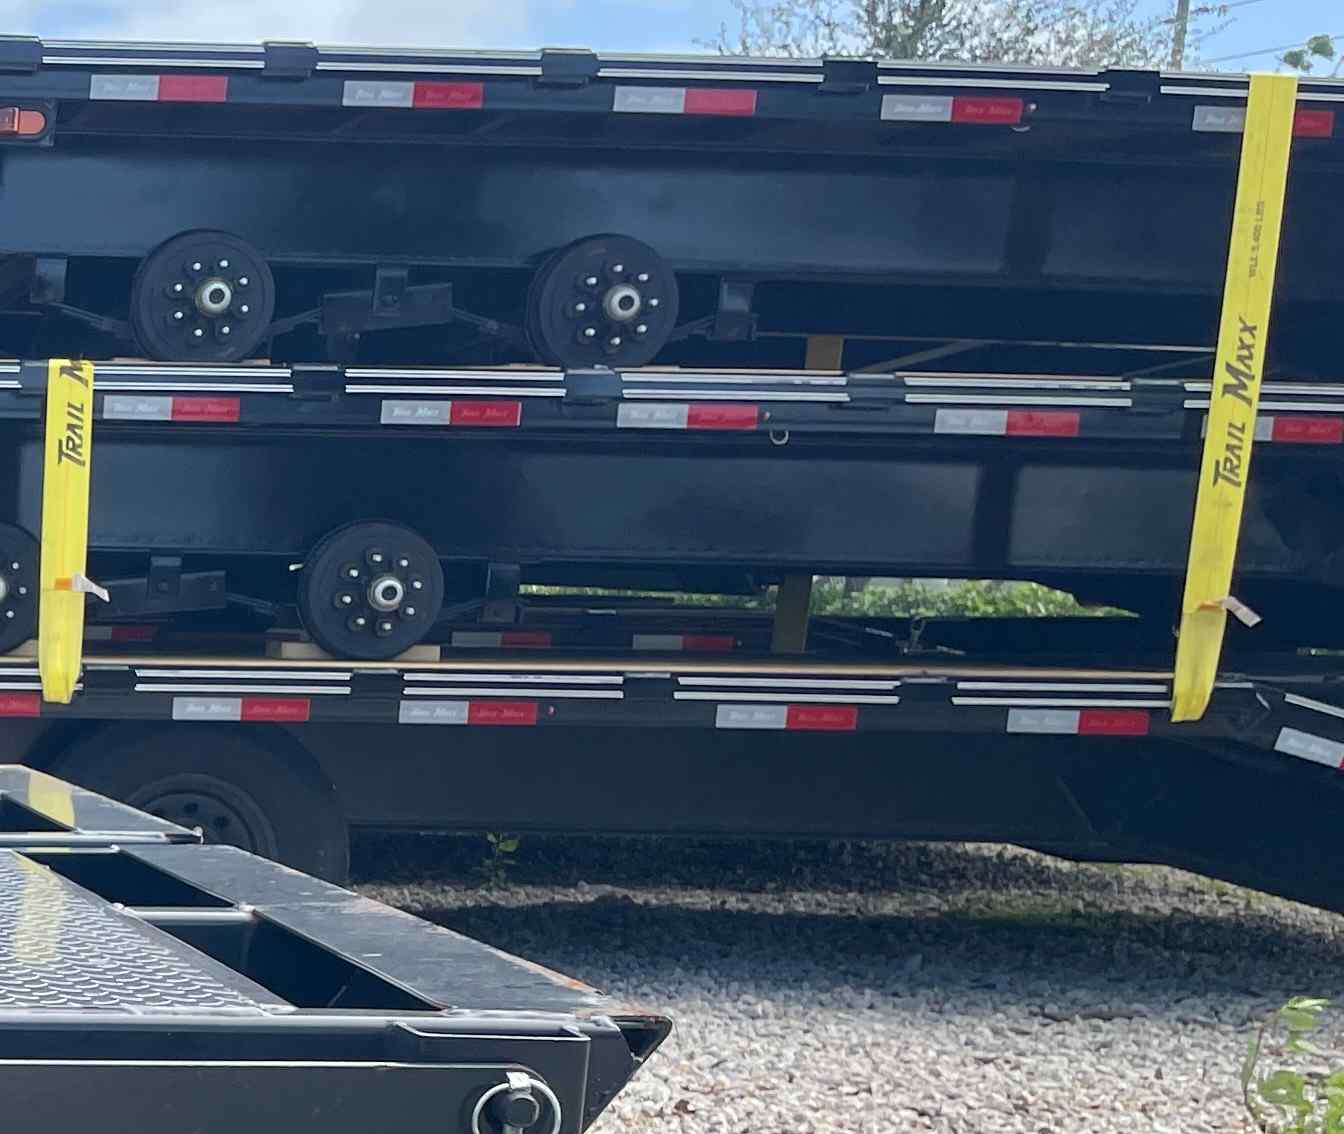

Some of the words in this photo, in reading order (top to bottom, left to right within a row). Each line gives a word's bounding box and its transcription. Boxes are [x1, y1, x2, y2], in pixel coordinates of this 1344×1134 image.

[1221, 319, 1257, 408] MAXX
[56, 400, 85, 468] TRAIL
[1212, 420, 1246, 488] TRAIL
